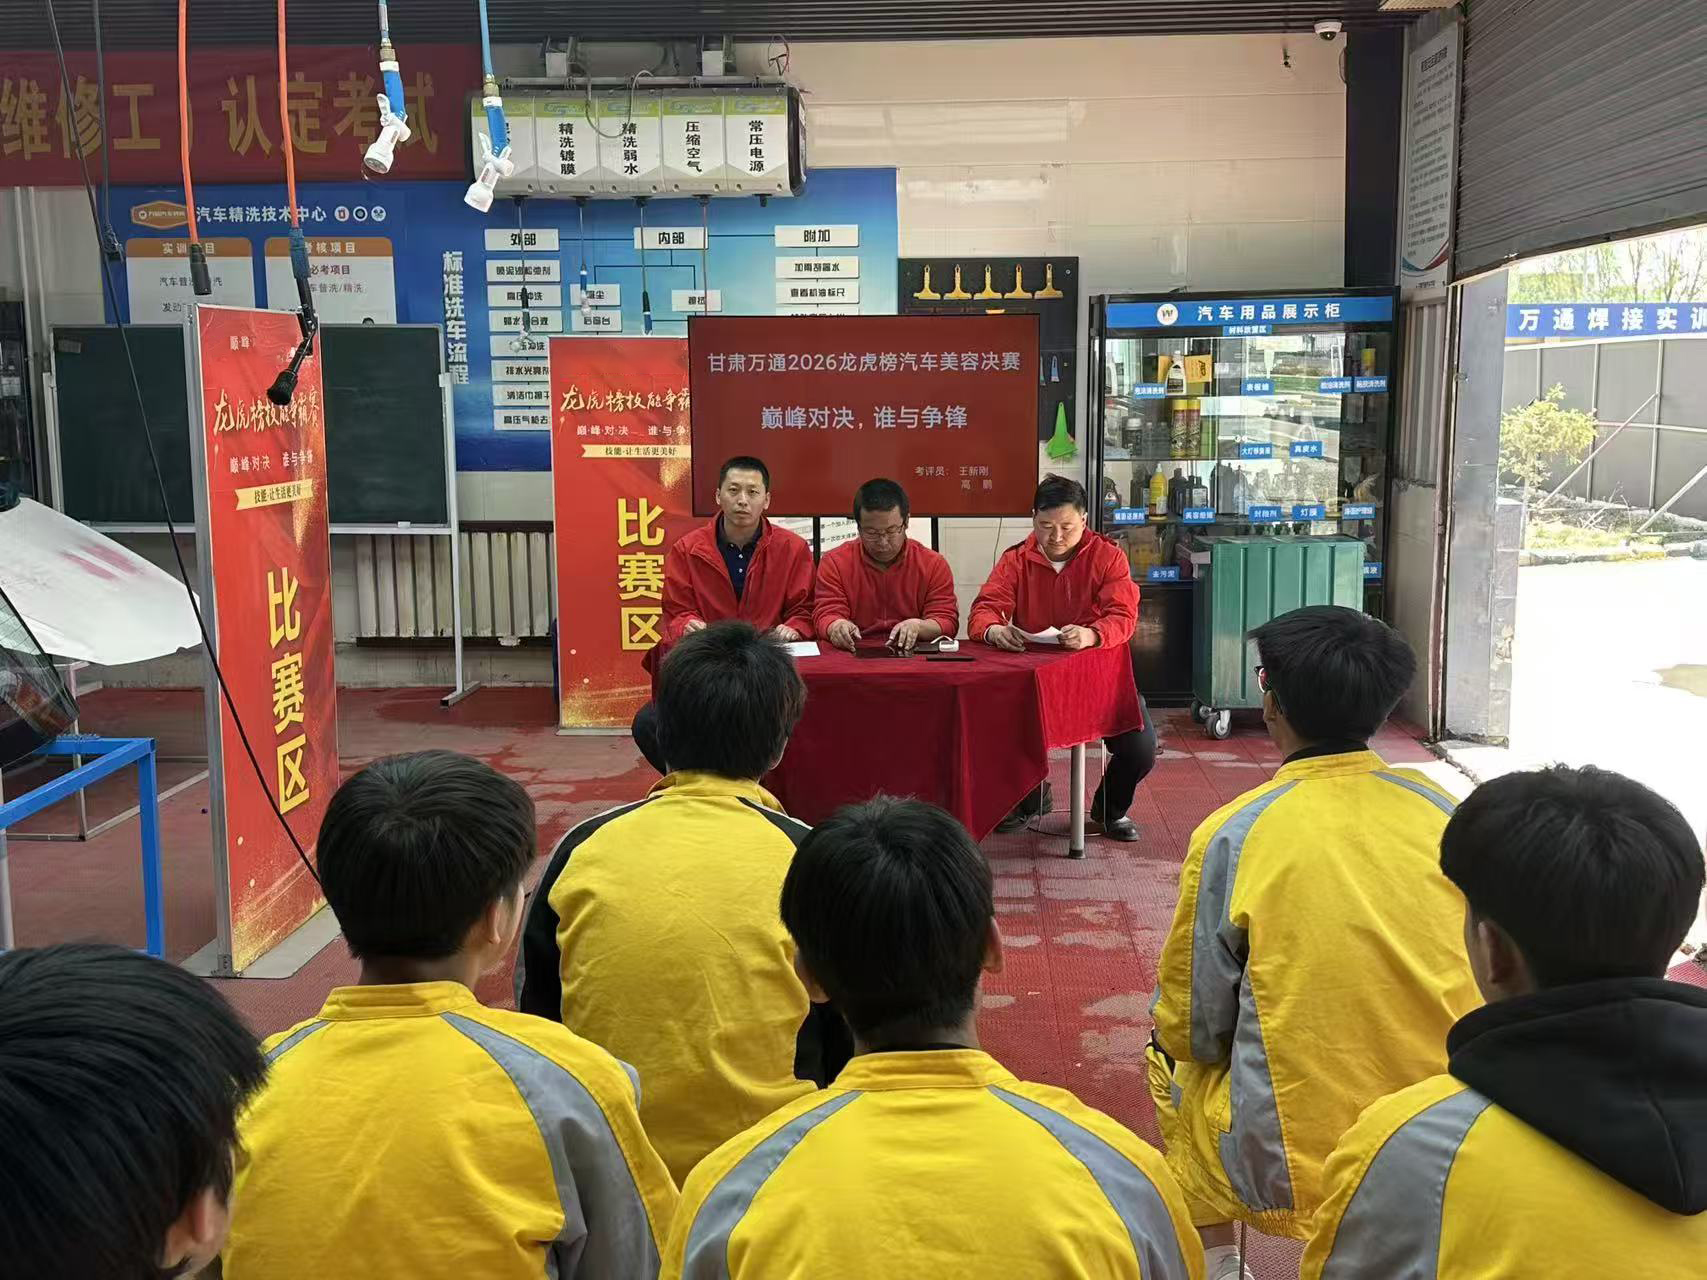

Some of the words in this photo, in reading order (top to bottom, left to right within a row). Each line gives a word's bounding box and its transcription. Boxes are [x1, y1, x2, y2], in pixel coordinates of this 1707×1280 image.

[559, 122, 577, 175] 精洗镀膜
[622, 121, 640, 175] 精洗弱水
[685, 121, 703, 173] 压缩空气
[748, 120, 765, 172] 常压电源
[196, 206, 327, 222] 汽车精洗技术中心
[510, 233, 537, 246] 外部
[658, 231, 685, 245] 内部
[803, 229, 831, 242] 附加
[162, 243, 215, 255] 实训目
[443, 251, 469, 384] 标准洗车流程
[1197, 303, 1341, 321] 汽车用品展示柜
[1518, 306, 1707, 331] 万通焊接实训
[708, 352, 1021, 373] 甘肃万通2026龙虎榜汽车美容决赛
[761, 405, 968, 430] 巅峰对决，谁与争锋
[617, 497, 665, 650] 比赛区
[1152, 570, 1175, 578] 去污泥
[267, 566, 310, 815] 比赛区
